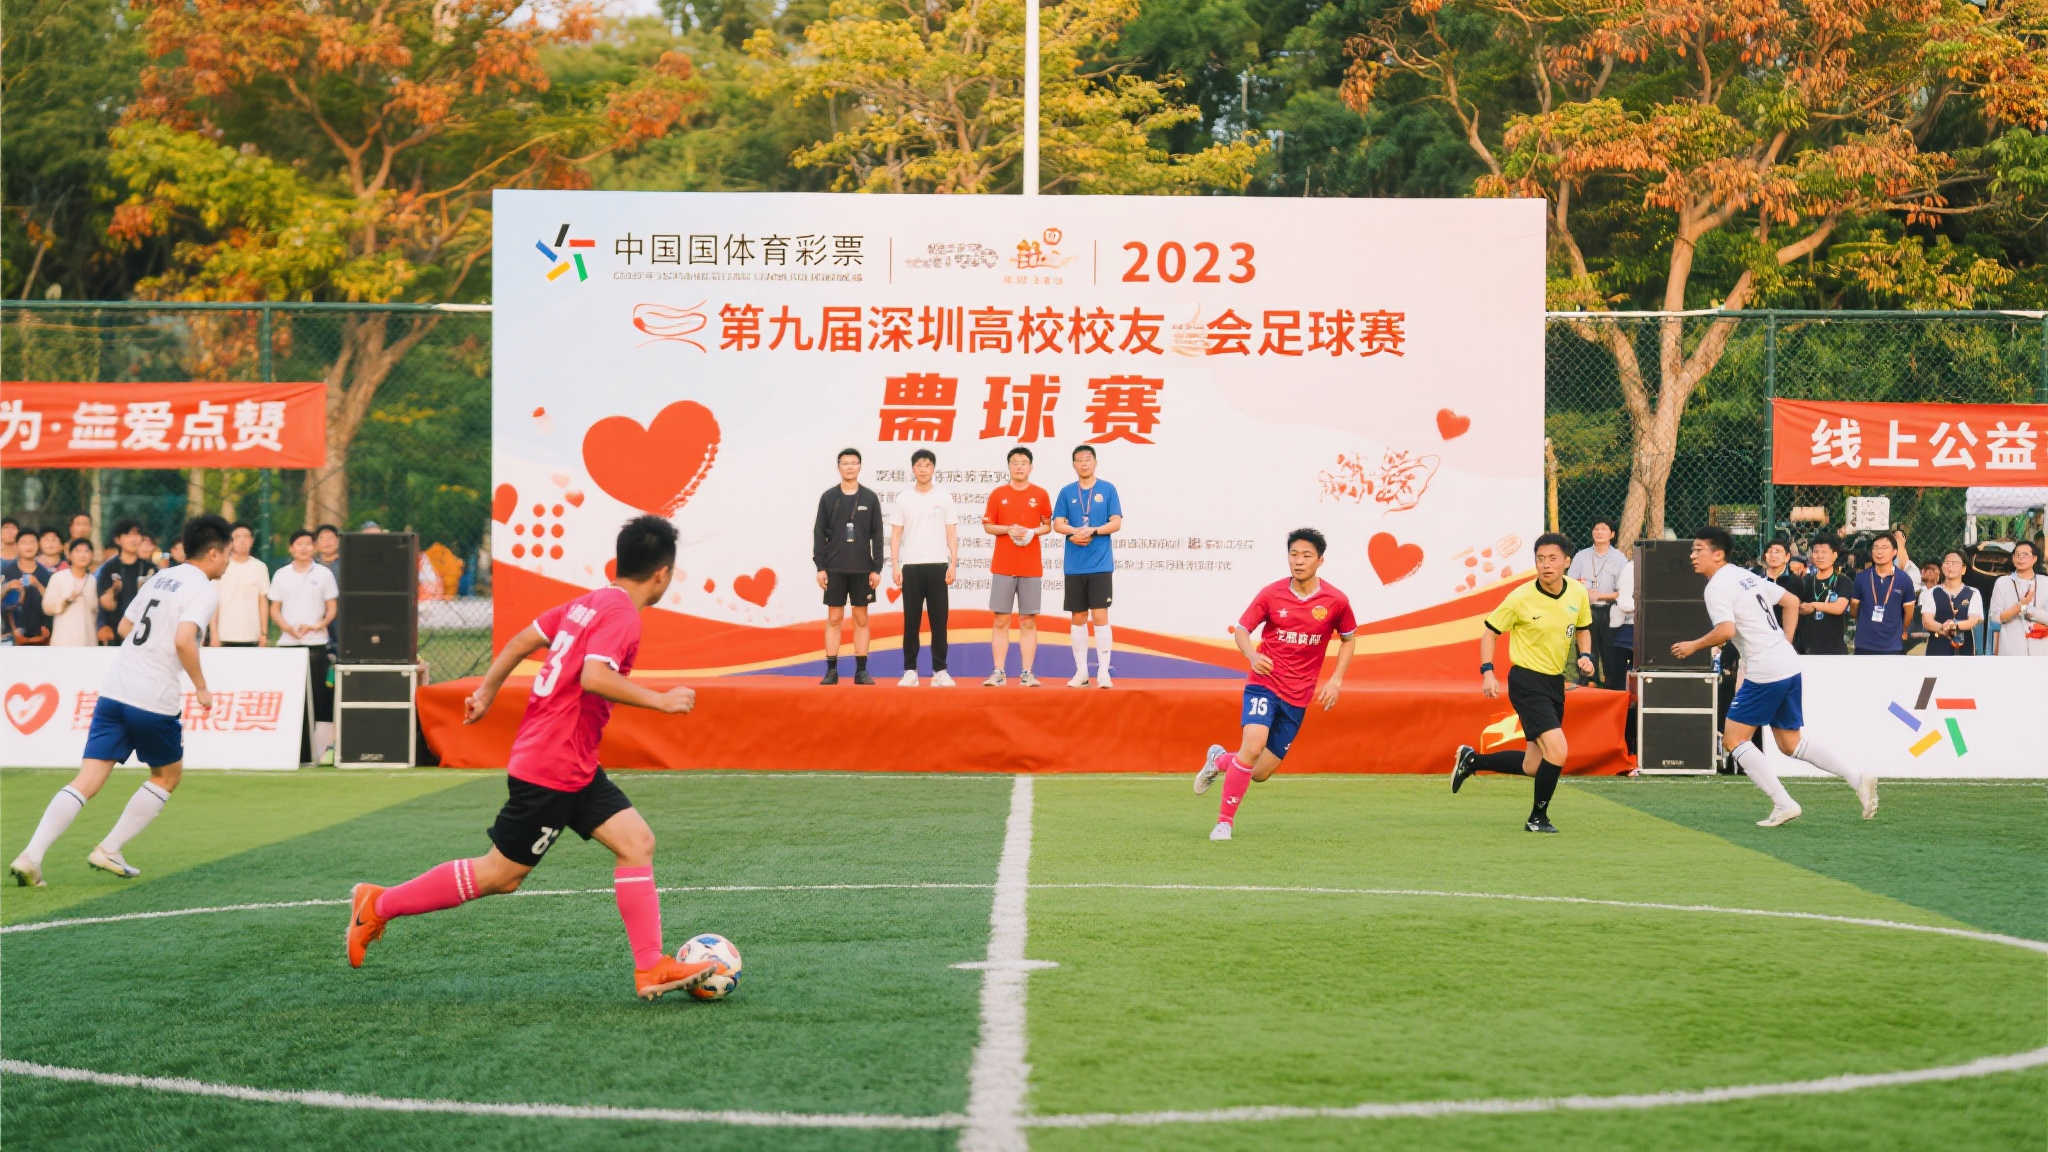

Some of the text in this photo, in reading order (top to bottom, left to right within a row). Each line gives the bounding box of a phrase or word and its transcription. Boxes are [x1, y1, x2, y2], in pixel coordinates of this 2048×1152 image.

[615, 232, 864, 267] 中国国体育彩票
[1122, 242, 1256, 283] 2023
[1810, 418, 2048, 470] 线上公益
[132, 598, 160, 646] 5
[533, 630, 575, 697] 3
